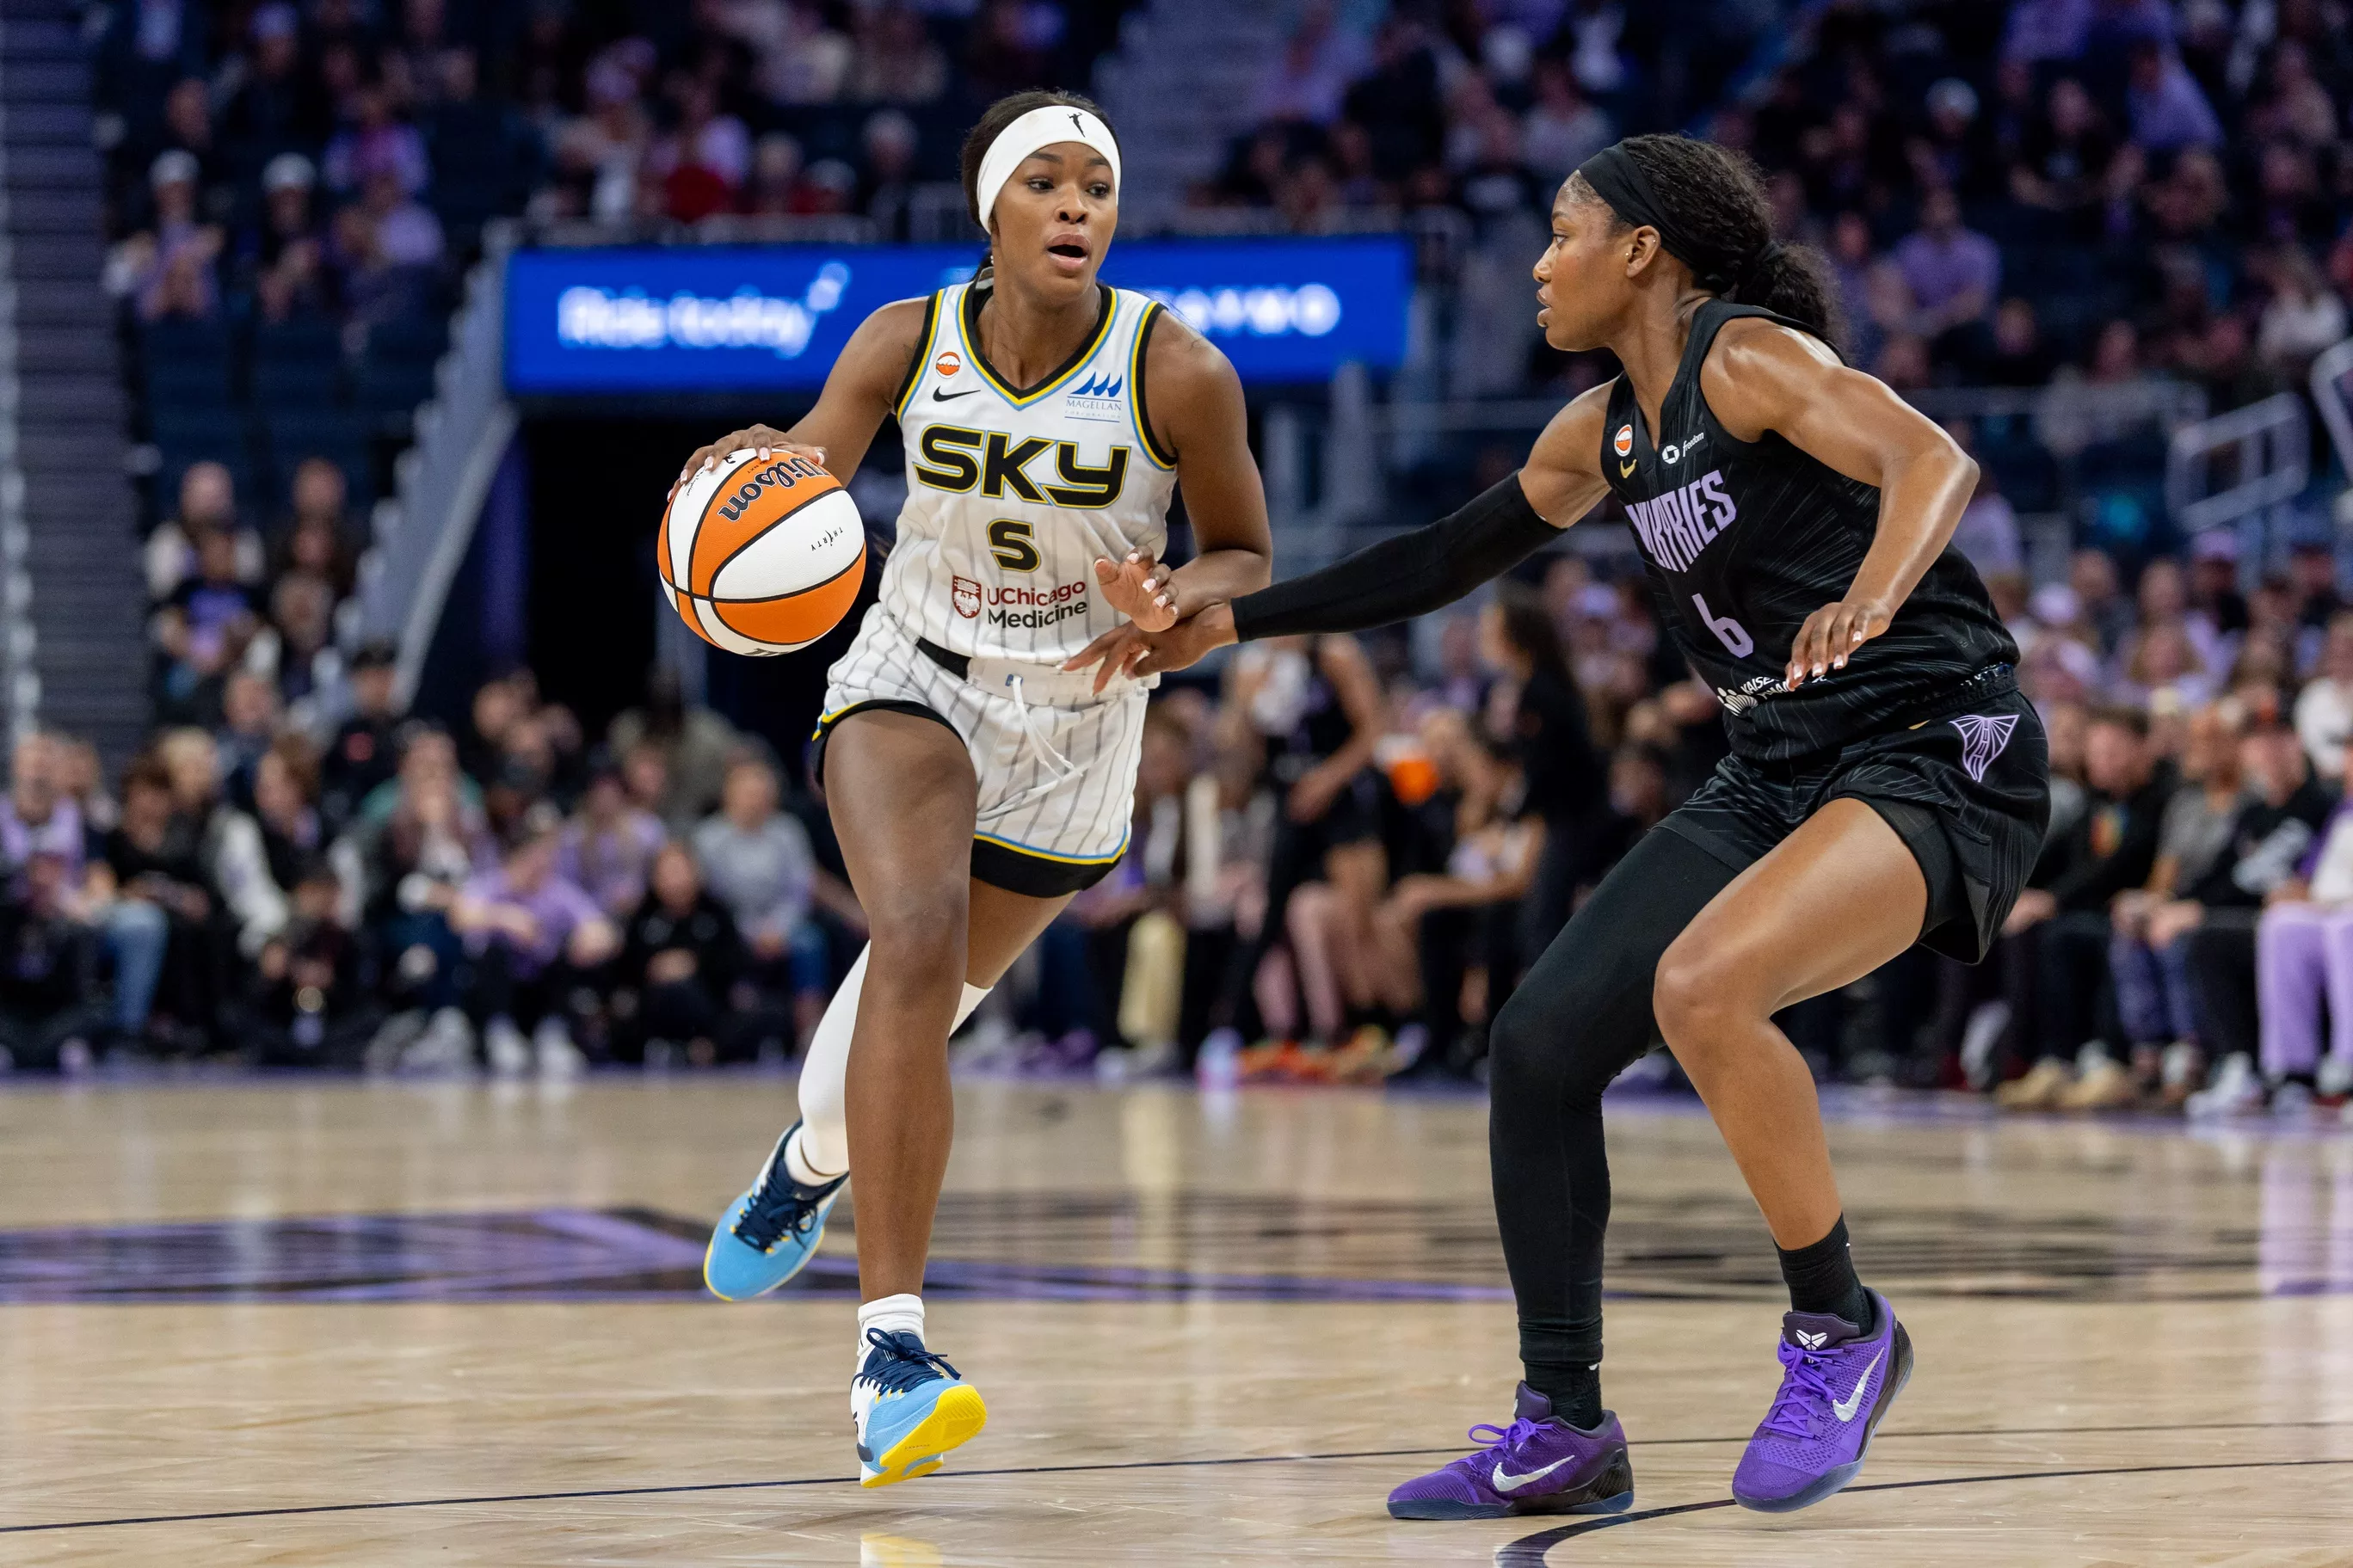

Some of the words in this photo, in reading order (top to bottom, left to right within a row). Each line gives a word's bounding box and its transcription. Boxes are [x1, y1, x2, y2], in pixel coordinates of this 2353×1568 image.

[1066, 399, 1122, 411] MAGELLAN
[1683, 432, 1704, 458] freedom
[912, 423, 1130, 509] SKY
[717, 457, 831, 522] Wilson
[986, 519, 1041, 572] 5
[987, 581, 1086, 606] UChicago
[988, 601, 1087, 629] Medicine
[1691, 593, 1753, 659] 6
[1740, 676, 1779, 695] KAISE
